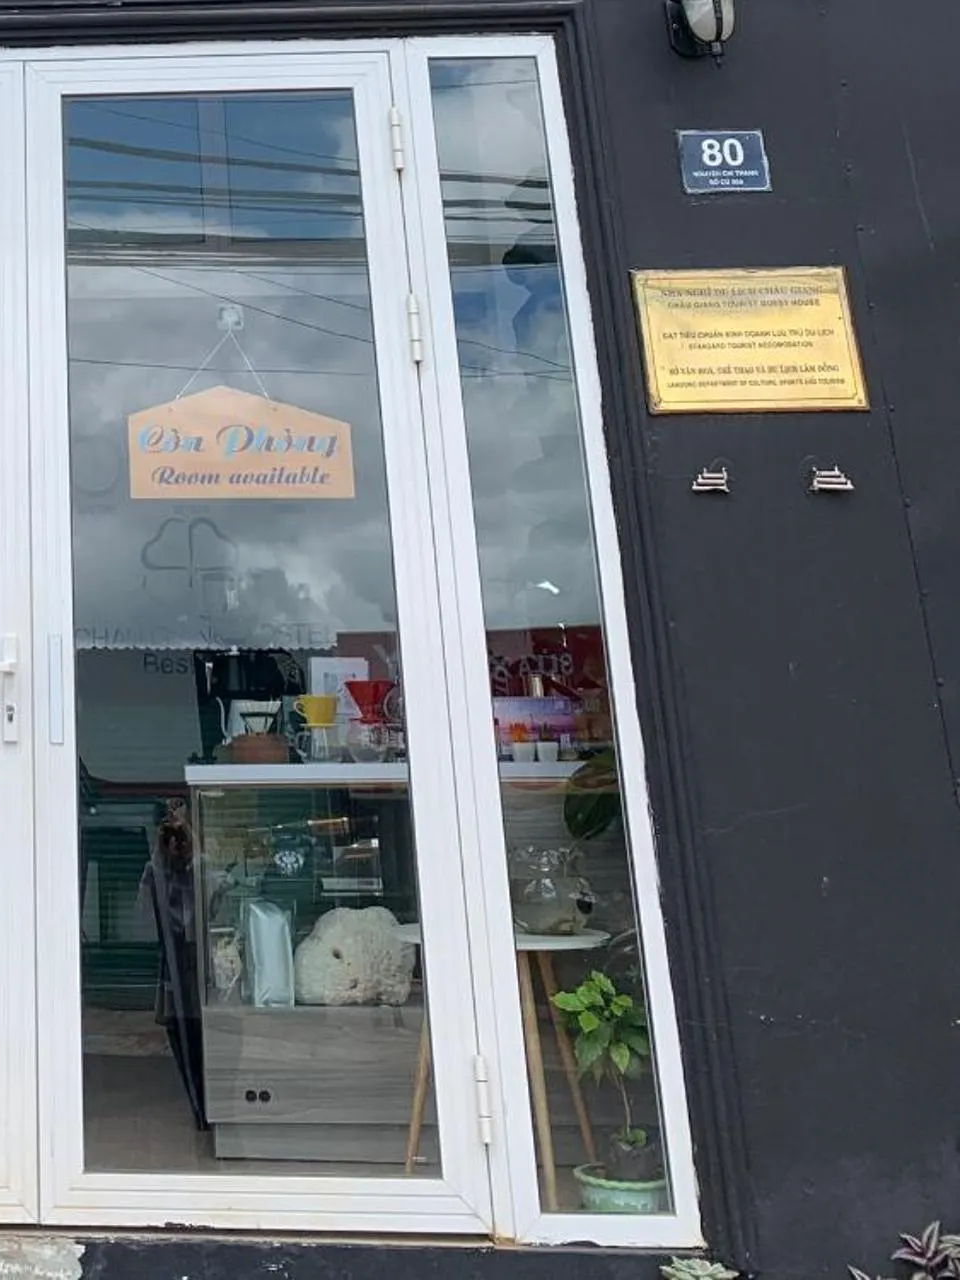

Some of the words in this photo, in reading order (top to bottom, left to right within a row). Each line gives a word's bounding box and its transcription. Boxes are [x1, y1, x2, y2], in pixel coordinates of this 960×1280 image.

[701, 138, 744, 166] 80
[137, 424, 205, 455] Còn
[215, 424, 339, 460] Phòng
[151, 466, 221, 486] Room
[228, 465, 332, 486] available
